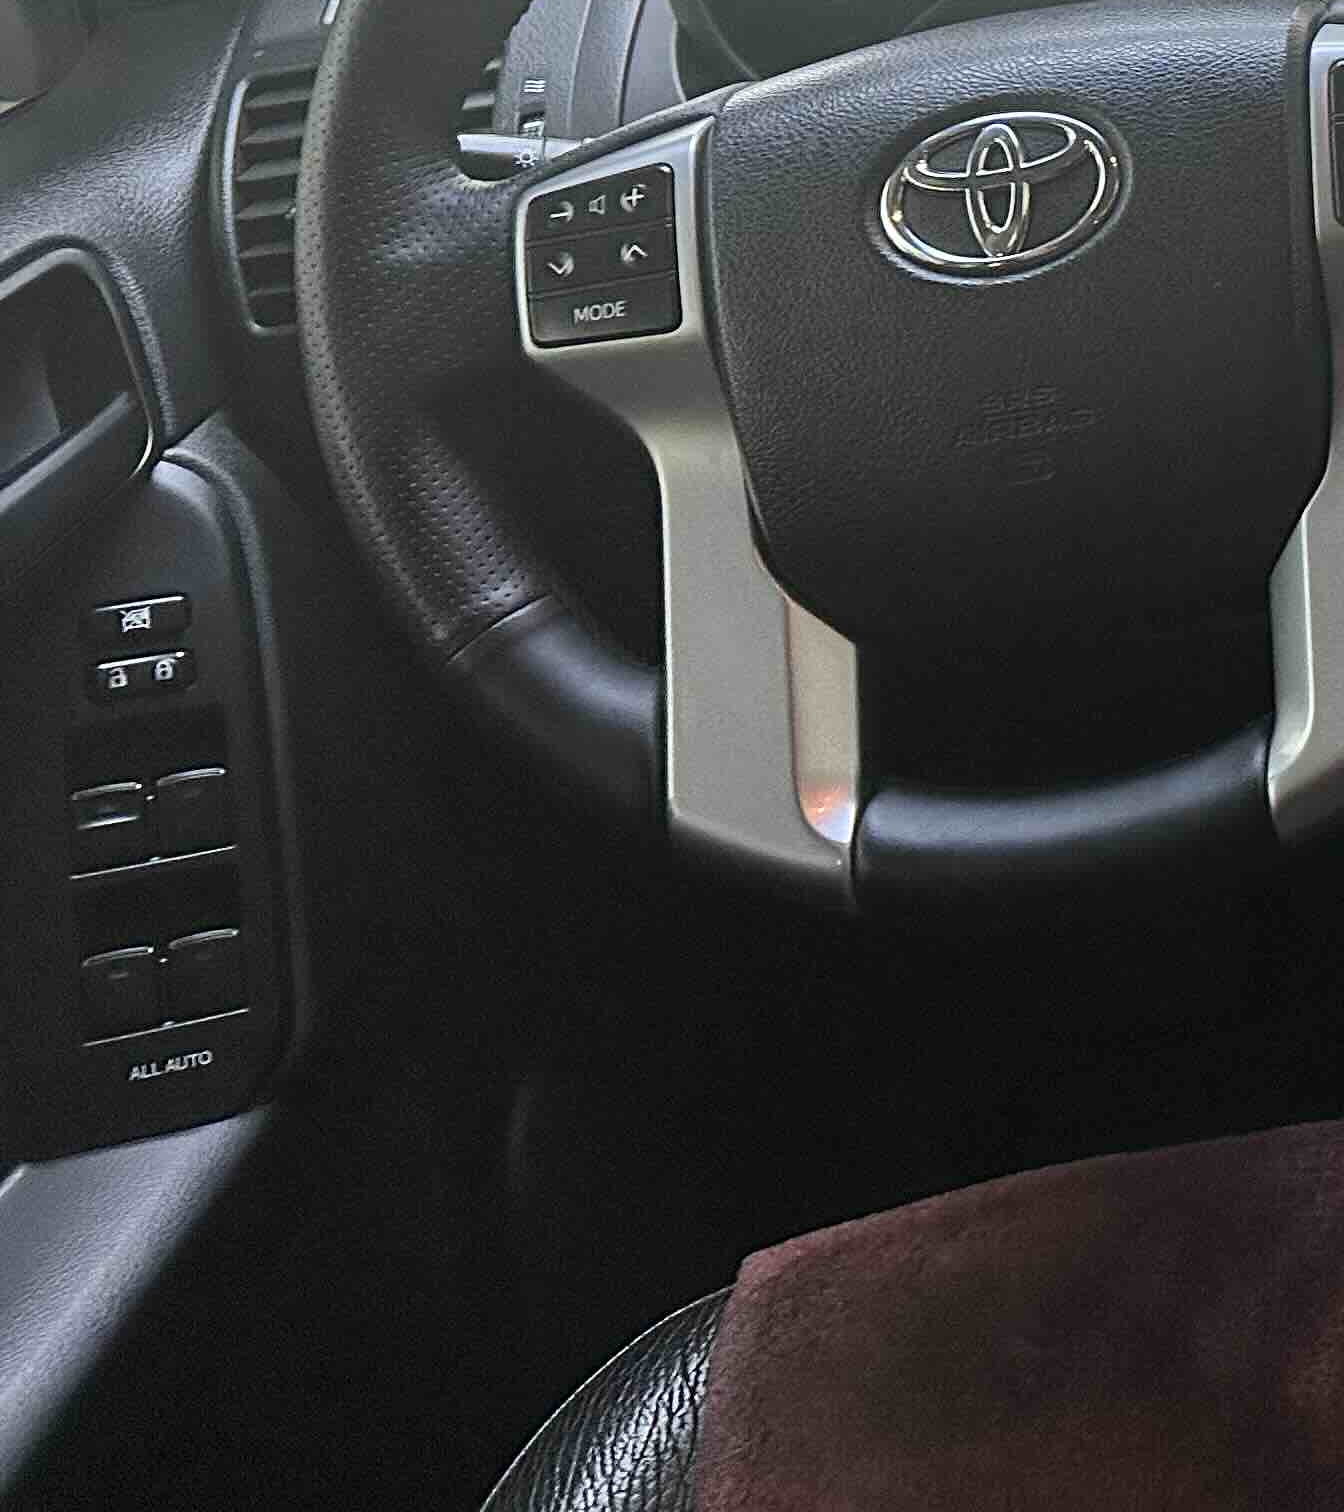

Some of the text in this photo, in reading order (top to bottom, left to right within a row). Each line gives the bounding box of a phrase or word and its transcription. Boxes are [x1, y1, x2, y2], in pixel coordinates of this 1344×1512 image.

[573, 299, 628, 326] MODE
[128, 1050, 213, 1081] ALL AUTO
